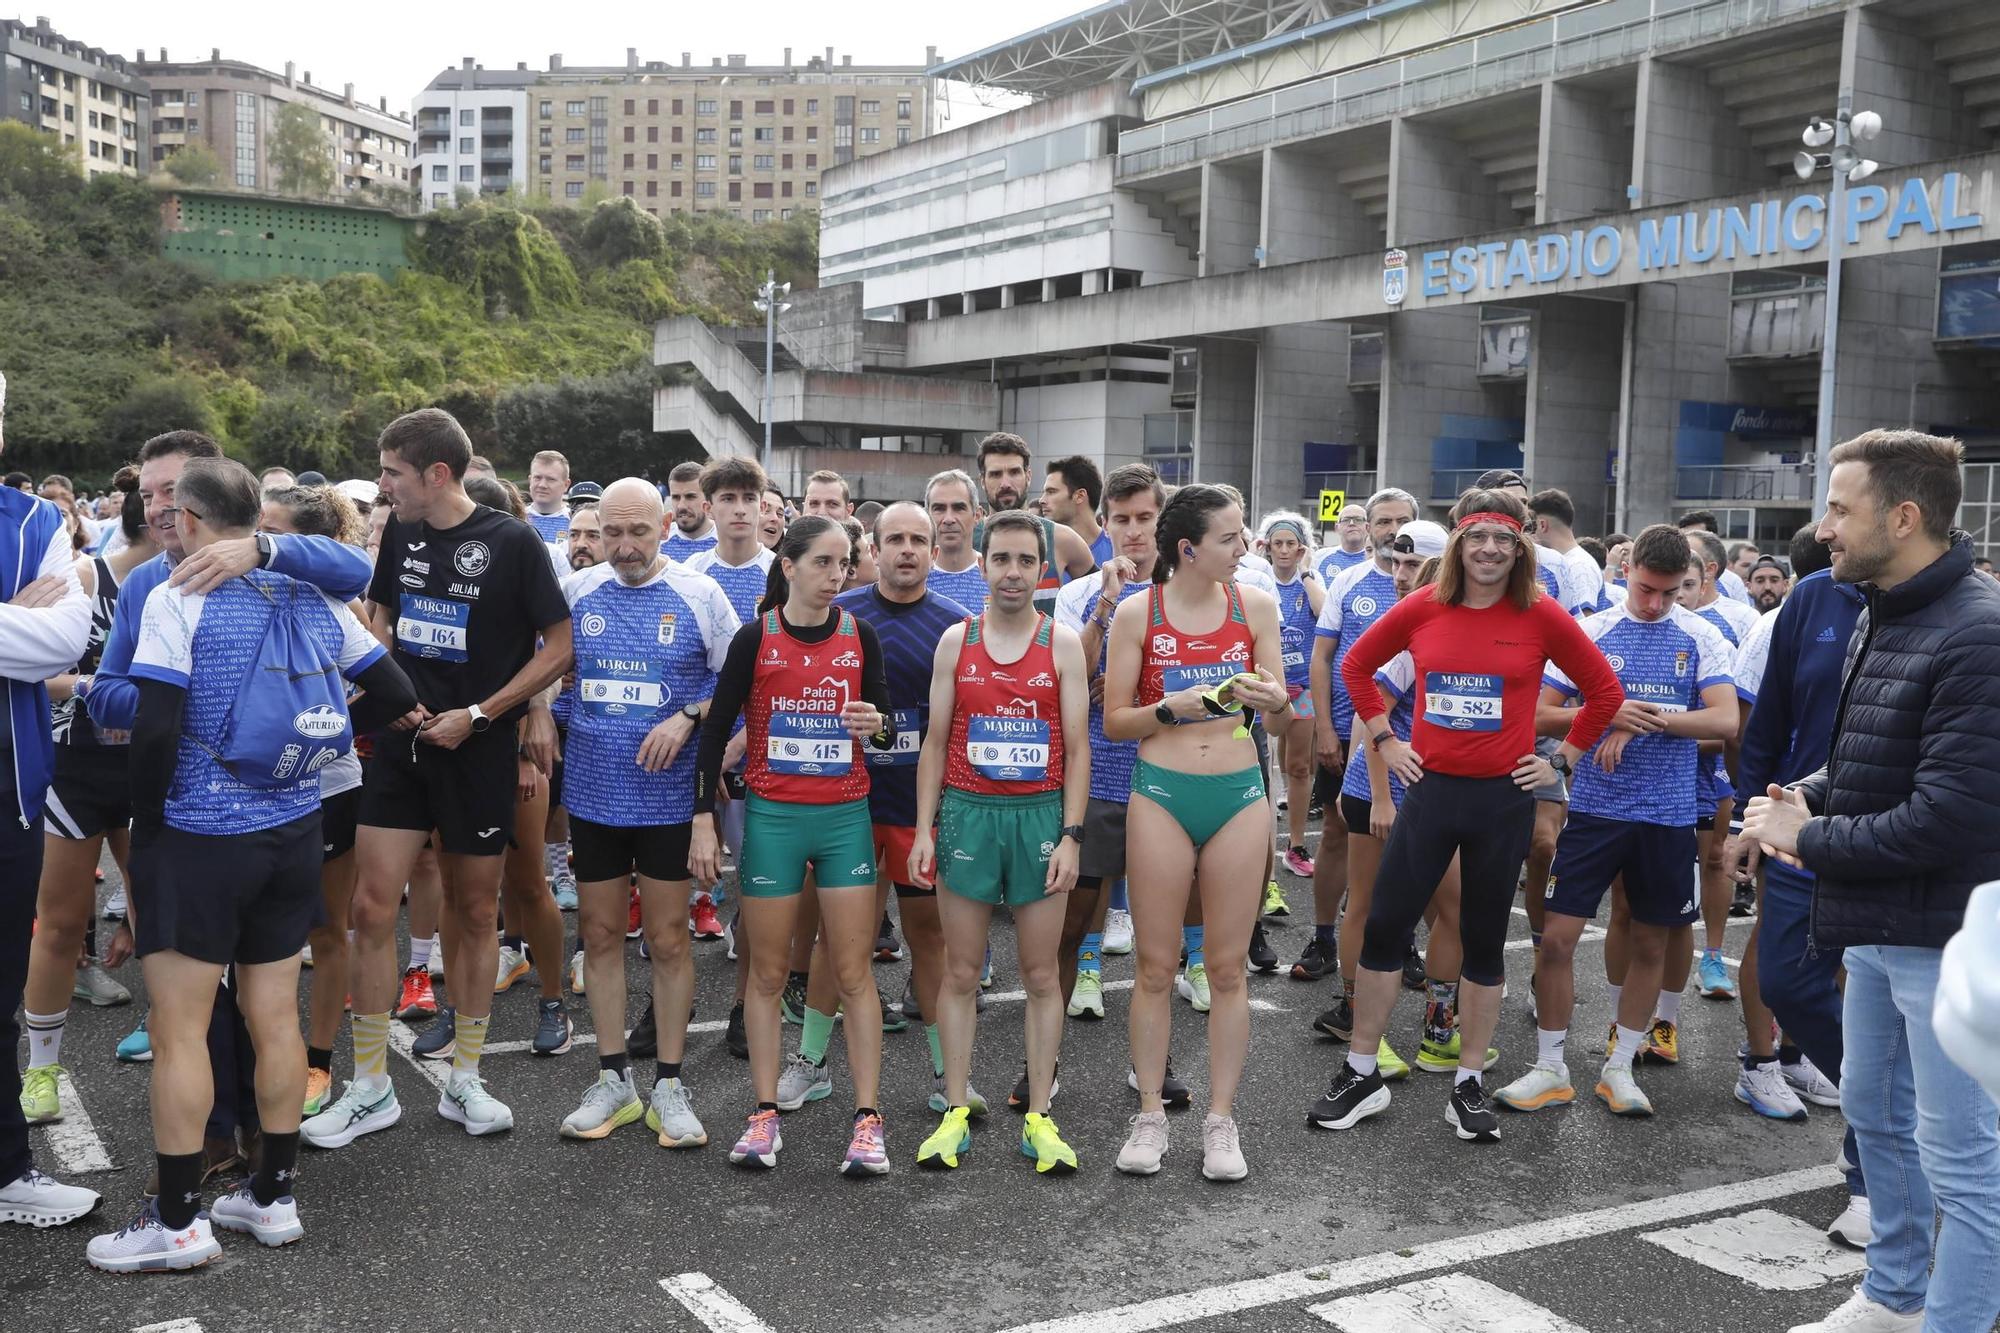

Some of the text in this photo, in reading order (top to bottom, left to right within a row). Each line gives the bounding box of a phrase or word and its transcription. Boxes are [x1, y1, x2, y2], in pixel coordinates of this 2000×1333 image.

[1423, 172, 1982, 297] ESTADIO MUNICPAL
[1730, 408, 1769, 432] fondo
[1322, 495, 1341, 516] P2
[448, 582, 480, 597] JULIÁN
[413, 599, 458, 616] MARCHA
[431, 628, 456, 646] 164
[596, 658, 648, 672] MARCHA
[831, 658, 860, 668] coa
[1149, 656, 1182, 666] Llanes
[1180, 665, 1235, 681] MARCHA
[1027, 678, 1053, 688] coa
[1441, 675, 1491, 688] MARCHA
[1626, 683, 1676, 695] MARCHA
[622, 685, 641, 701] 81
[802, 686, 837, 698] Patria
[771, 696, 836, 713] Hispana
[996, 705, 1026, 716] Patria
[1462, 700, 1493, 716] 582
[785, 716, 840, 729] MARCHA
[984, 720, 1038, 733] MARCHA
[811, 743, 840, 760] 415
